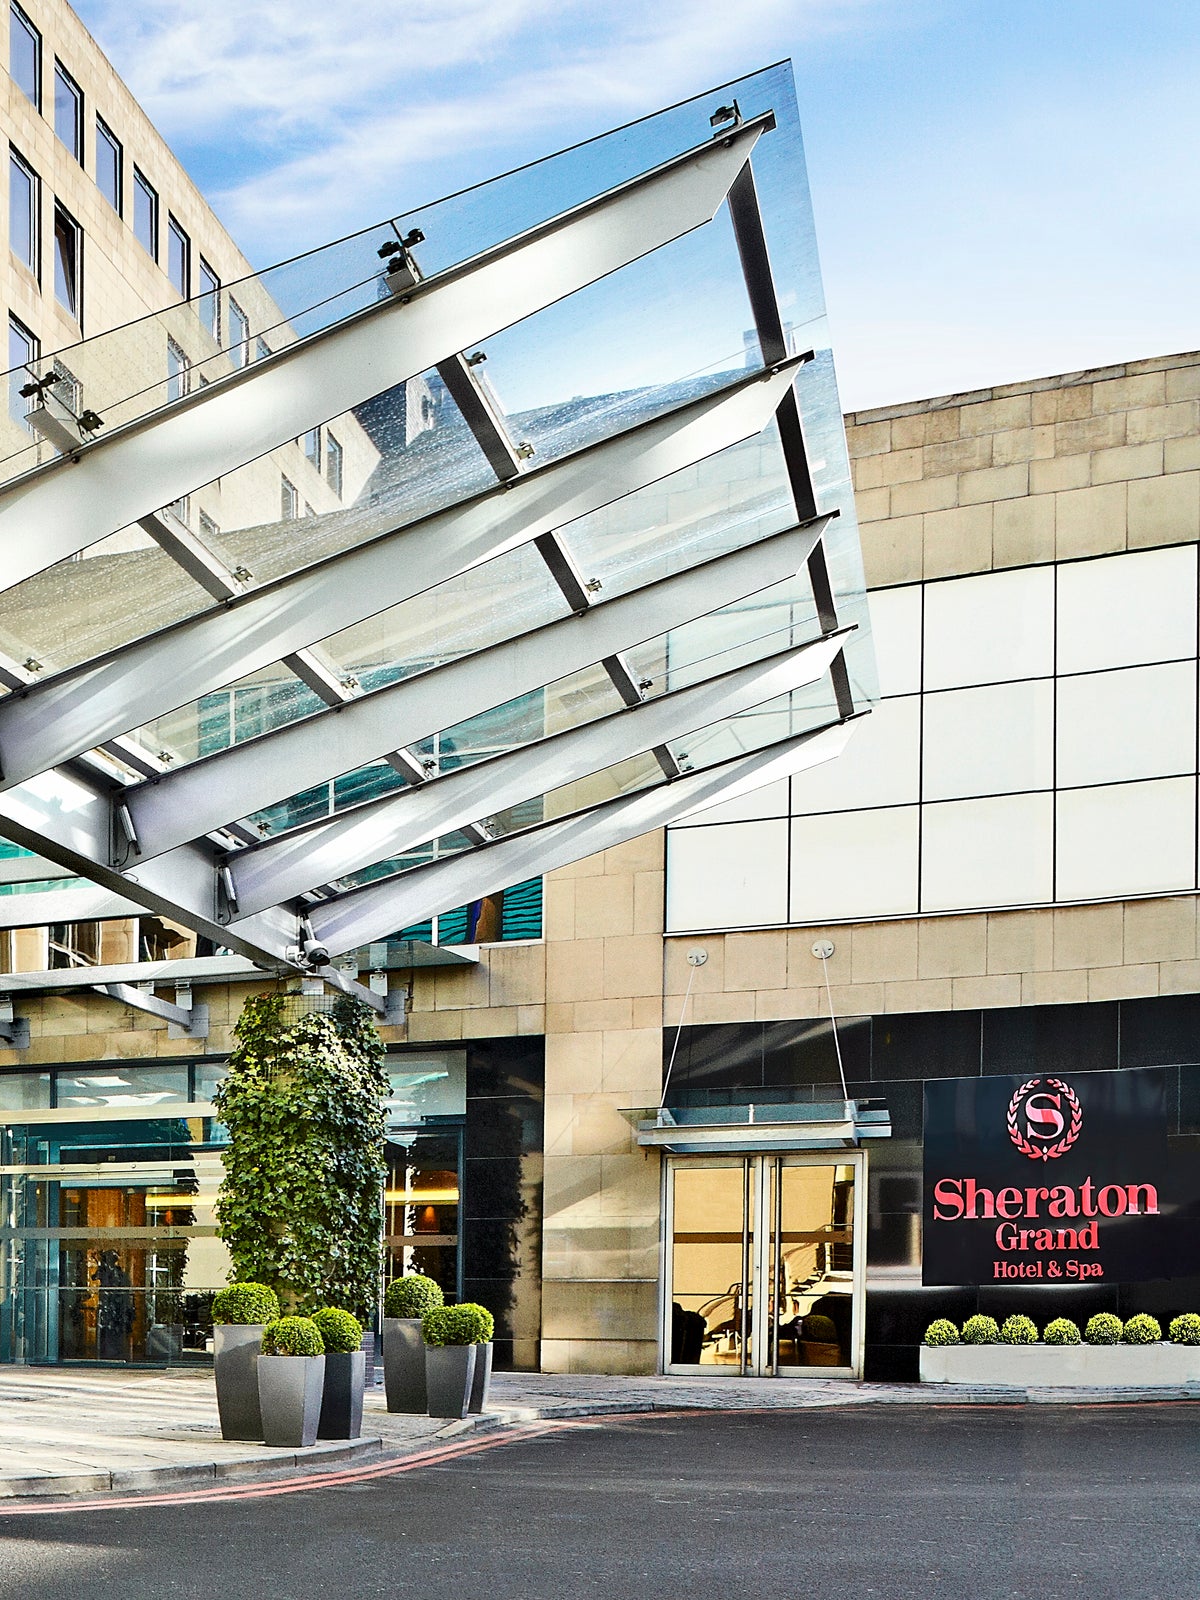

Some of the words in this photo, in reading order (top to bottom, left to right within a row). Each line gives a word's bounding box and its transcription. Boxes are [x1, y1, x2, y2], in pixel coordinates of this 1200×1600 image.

[933, 1176, 1161, 1220] Sheraton
[995, 1221, 1100, 1251] Grand
[993, 1261, 1043, 1278] Hotel
[1047, 1261, 1063, 1278] &
[1066, 1260, 1104, 1280] Spa
